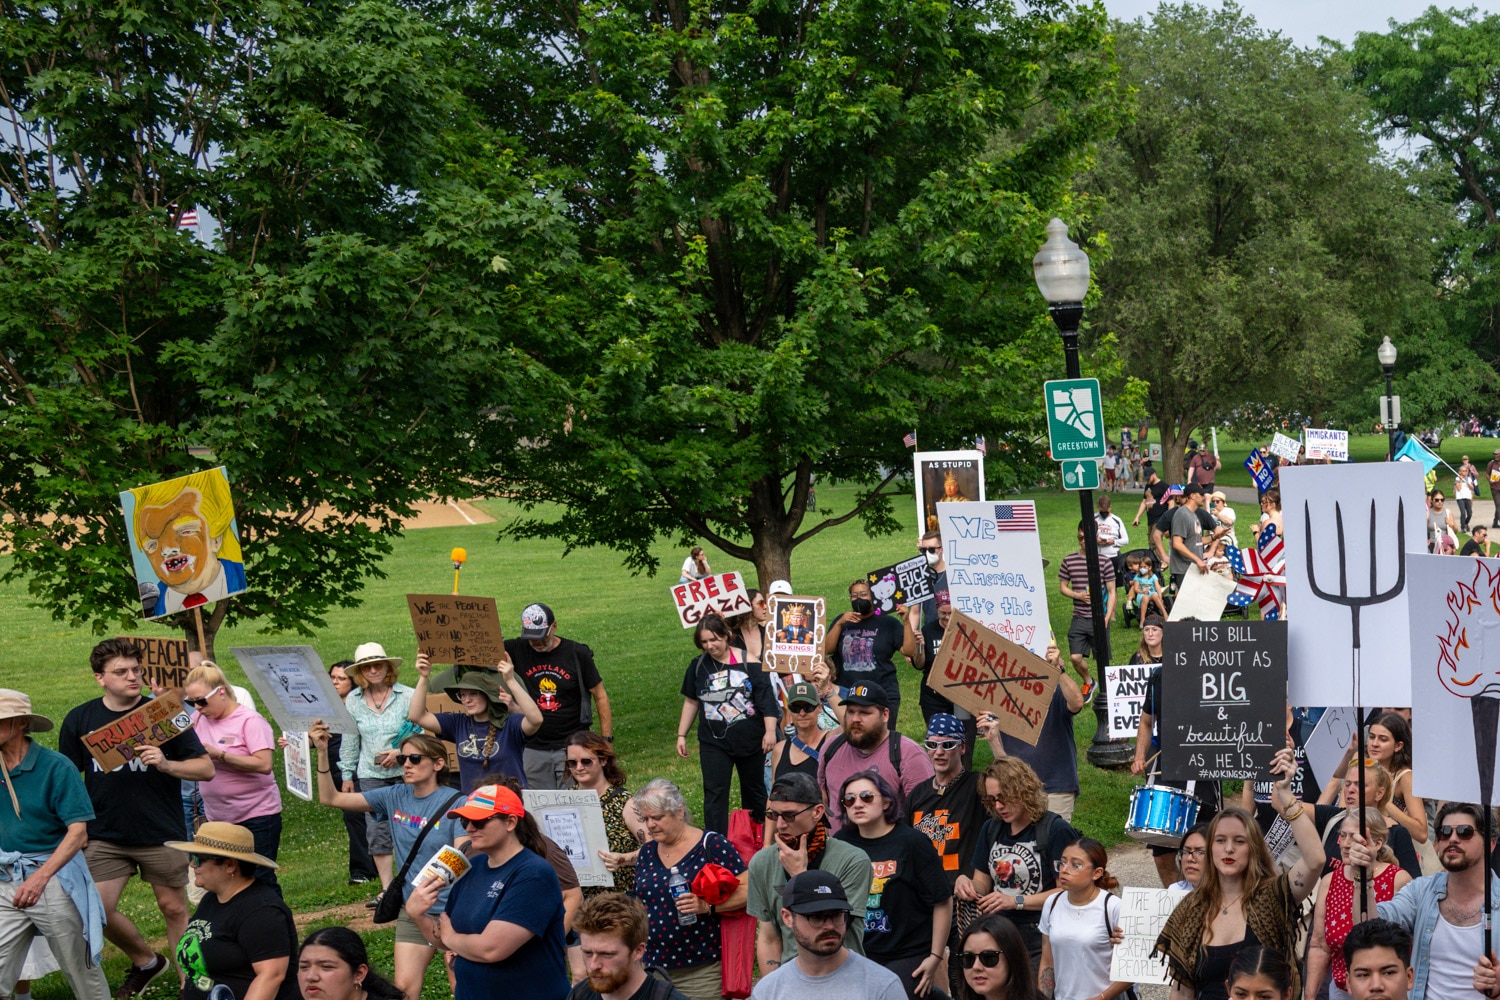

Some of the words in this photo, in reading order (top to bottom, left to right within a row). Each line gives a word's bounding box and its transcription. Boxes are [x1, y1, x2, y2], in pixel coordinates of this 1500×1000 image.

[1307, 430, 1346, 441] IMMIGRANTS
[1057, 441, 1099, 451] GREEKTOWN
[1258, 469, 1269, 482] NO
[949, 516, 996, 540] We
[949, 540, 999, 567] Love
[899, 564, 930, 588] FUCK
[950, 569, 1035, 592] America,
[674, 573, 739, 606] FREE
[904, 580, 930, 601] ICE
[414, 602, 436, 615] WE
[455, 601, 489, 611] PEOPLE
[683, 595, 751, 624] GAZA
[957, 596, 994, 614] It's
[1001, 597, 1033, 616] the
[436, 614, 450, 625] NO
[418, 632, 432, 641] WE
[450, 631, 462, 640] NO
[1192, 626, 1219, 642] HIS
[1228, 626, 1257, 642] BILL
[452, 646, 466, 659] YES
[471, 656, 499, 664] PEACE
[951, 622, 1044, 696] MARALAGO
[1175, 652, 1187, 666] IS
[1199, 650, 1245, 667] ABOUT
[1252, 651, 1272, 668] AS
[525, 664, 571, 680] MARYLAND
[1202, 671, 1247, 701] BIG
[1000, 693, 1042, 726] ALLES
[1217, 706, 1228, 720] &
[88, 712, 147, 752] TRUMP
[1188, 754, 1205, 767] AS
[1215, 753, 1233, 767] HE
[1240, 754, 1264, 770] IS...
[1199, 770, 1258, 779] #NOKINGSDAY
[530, 794, 549, 807] NO
[1011, 845, 1040, 873] NIGHT
[1127, 891, 1150, 911] THE
[1120, 916, 1144, 936] THE
[1119, 959, 1158, 977] PEOPLE
